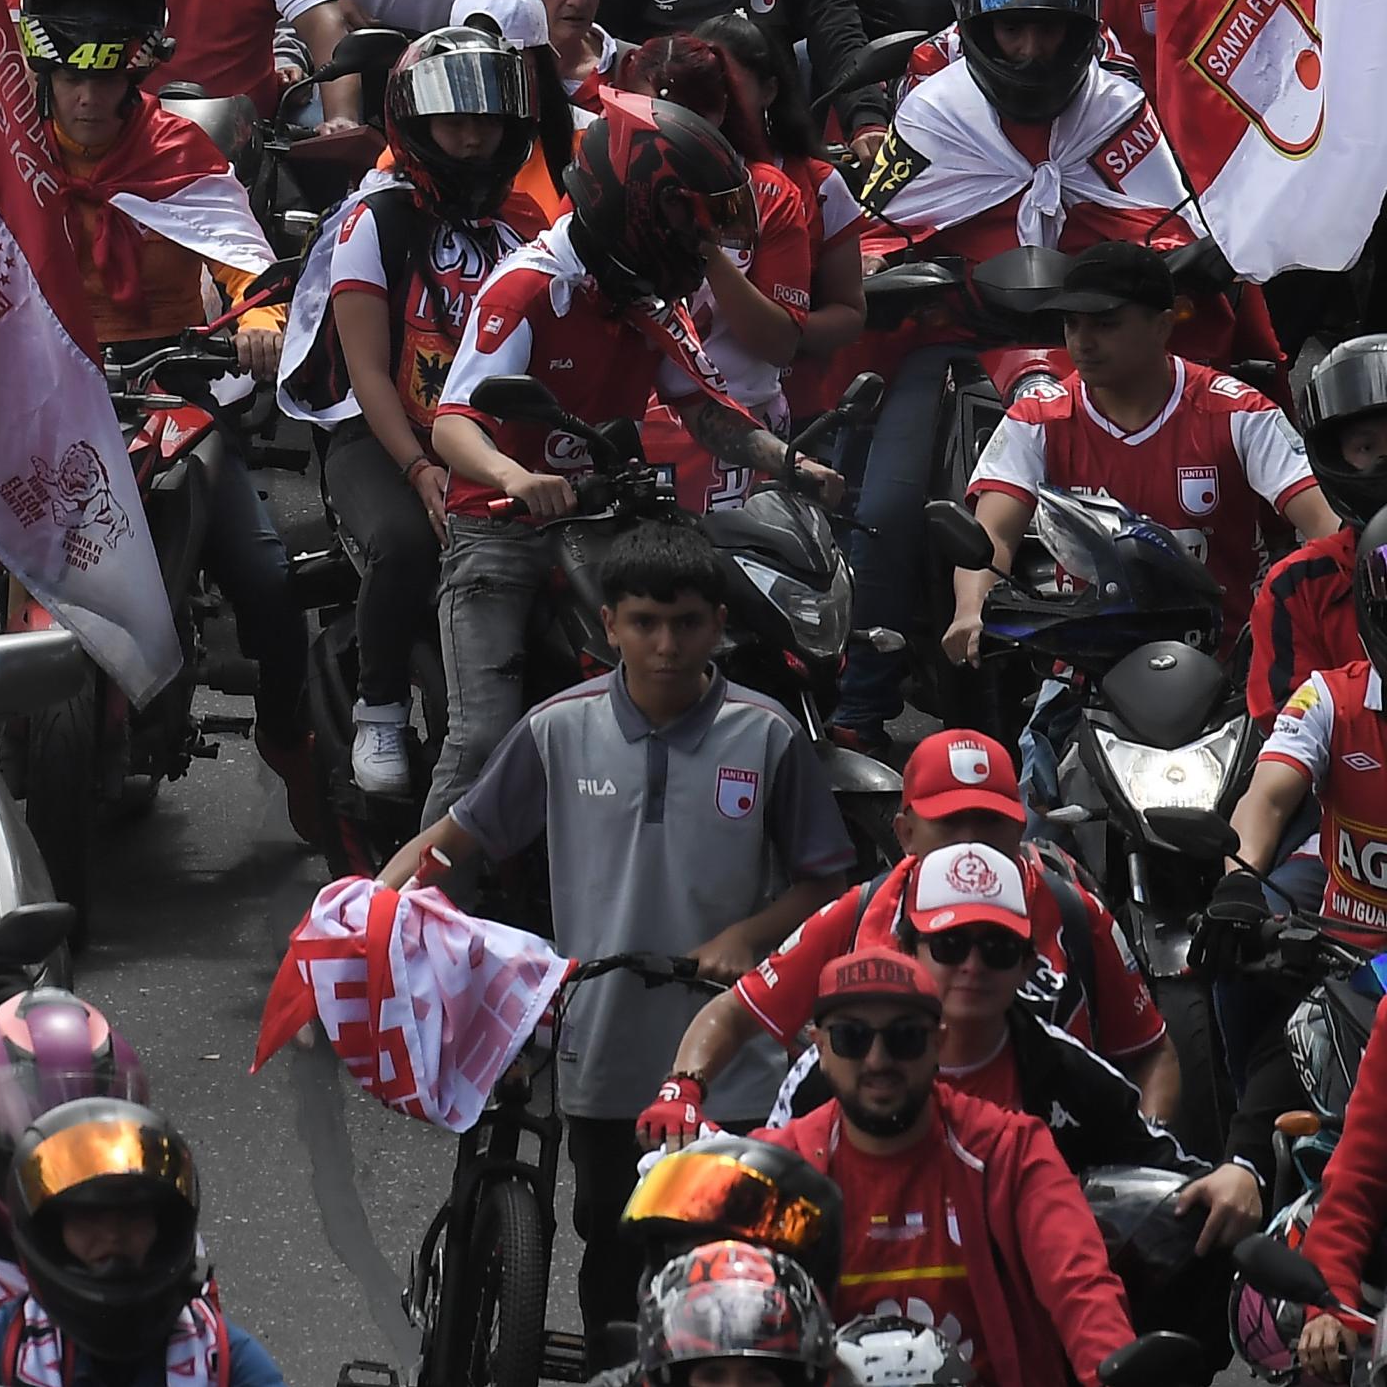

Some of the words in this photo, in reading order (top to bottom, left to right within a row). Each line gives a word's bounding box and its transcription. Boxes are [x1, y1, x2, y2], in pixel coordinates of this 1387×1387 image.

[1208, 12, 1258, 77] SANTA
[68, 42, 124, 69] 46
[549, 358, 574, 371] FILA
[1180, 469, 1204, 478] SANTA
[1205, 469, 1215, 478] FE
[720, 770, 745, 781] SANTA
[746, 773, 757, 783] FE
[578, 778, 616, 796] FILA
